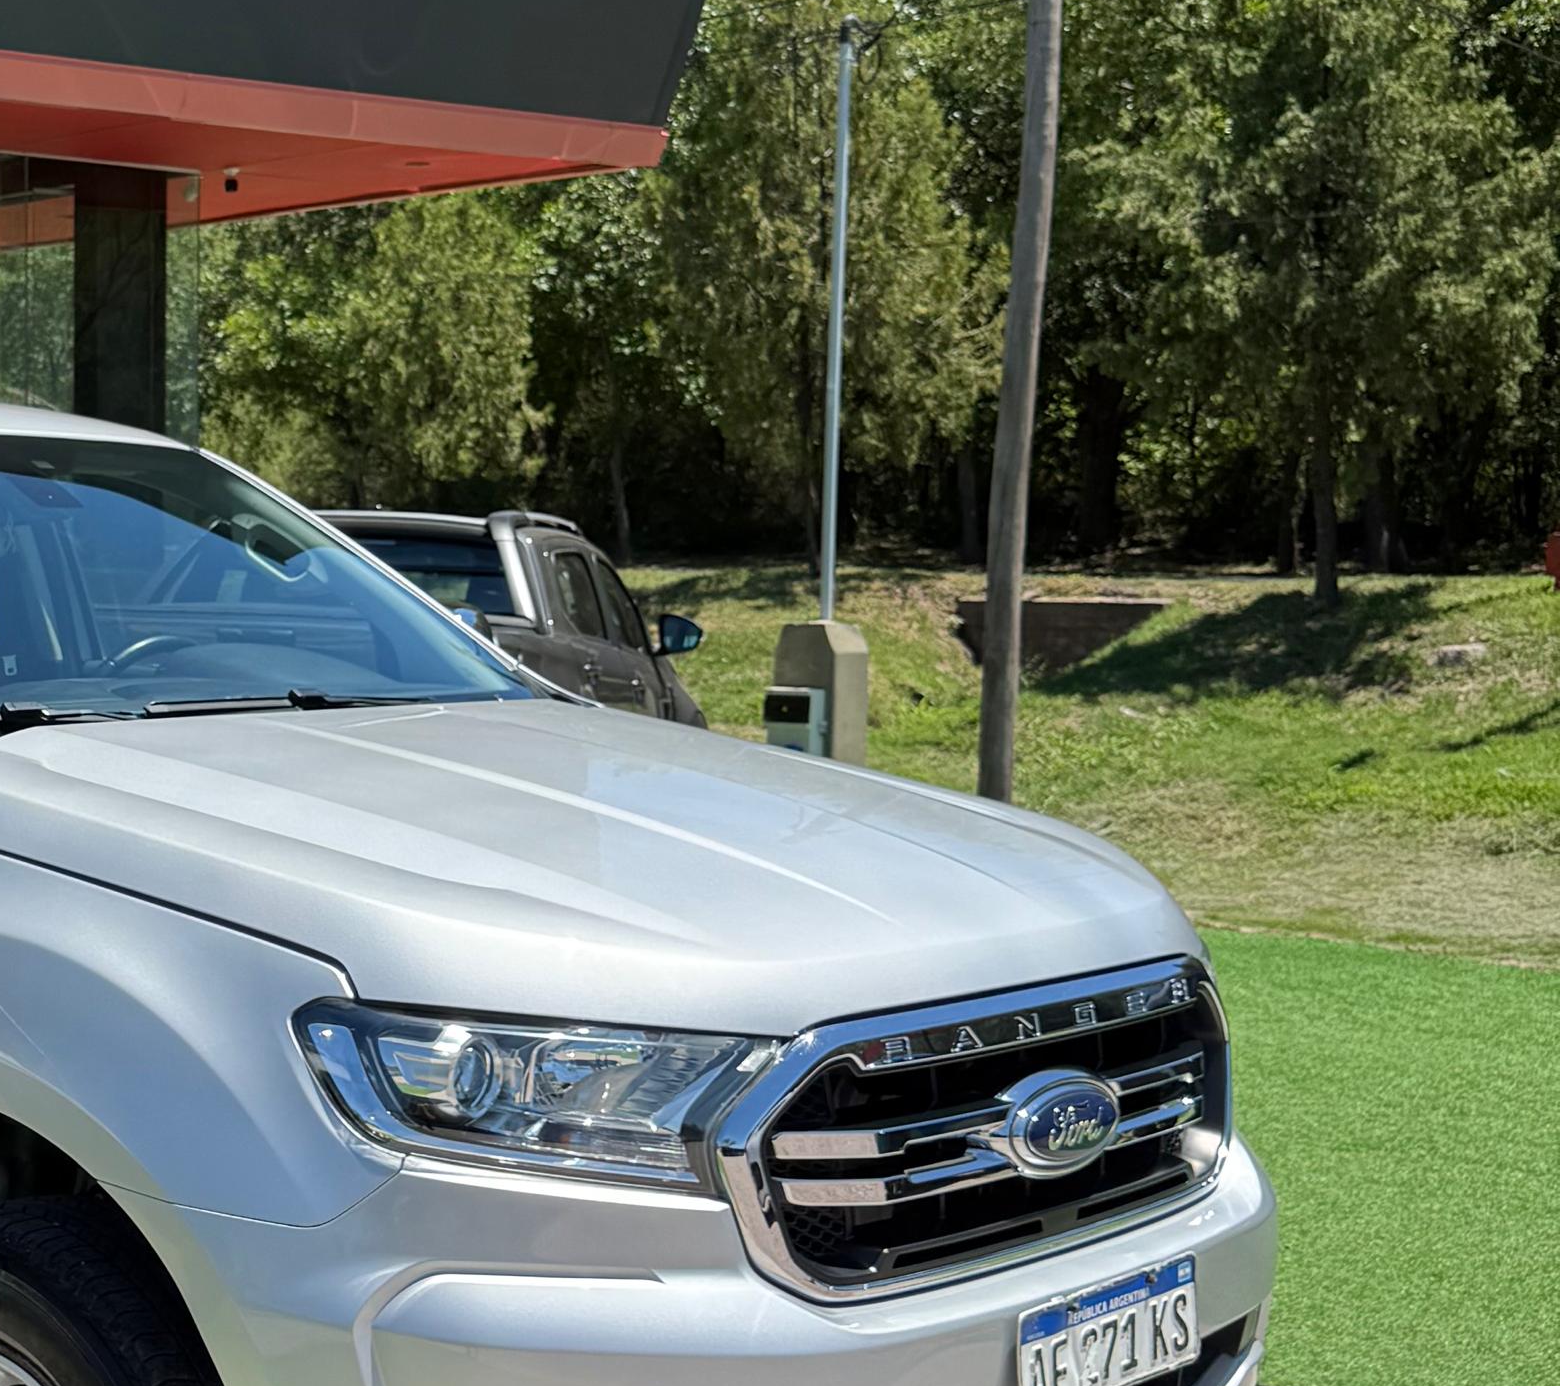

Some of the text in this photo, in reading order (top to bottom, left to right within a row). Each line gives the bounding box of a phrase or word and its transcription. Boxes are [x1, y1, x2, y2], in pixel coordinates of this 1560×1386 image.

[880, 977, 1190, 1063] RANGER
[1048, 1099, 1104, 1151] Ford
[1150, 1292, 1189, 1361] KS
